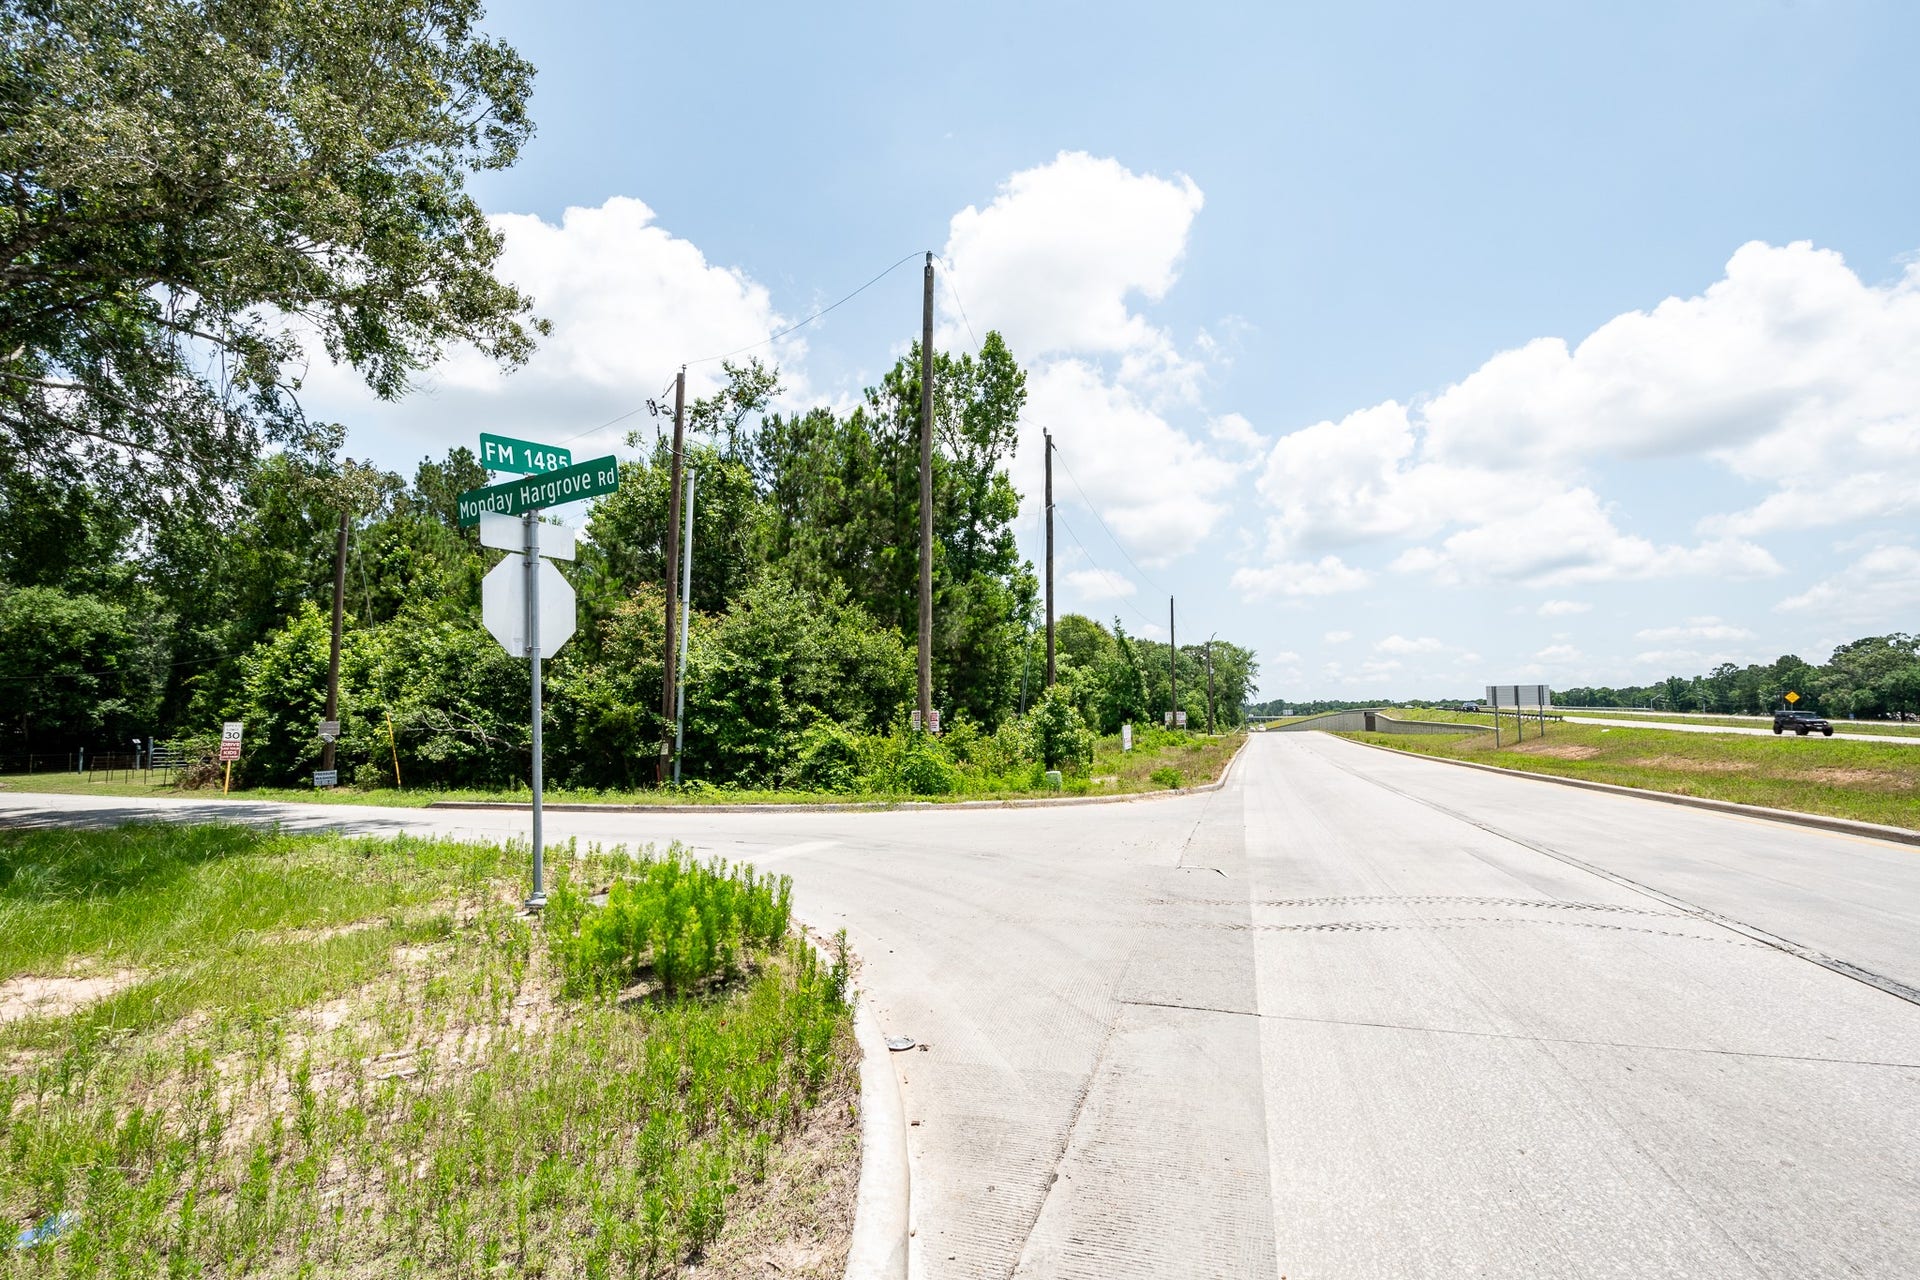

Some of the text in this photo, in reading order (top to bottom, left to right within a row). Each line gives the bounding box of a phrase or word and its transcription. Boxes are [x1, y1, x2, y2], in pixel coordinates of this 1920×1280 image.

[485, 441, 569, 471] FM 1485
[459, 468, 615, 520] Monday Hargrove Rd
[225, 731, 240, 739] 30
